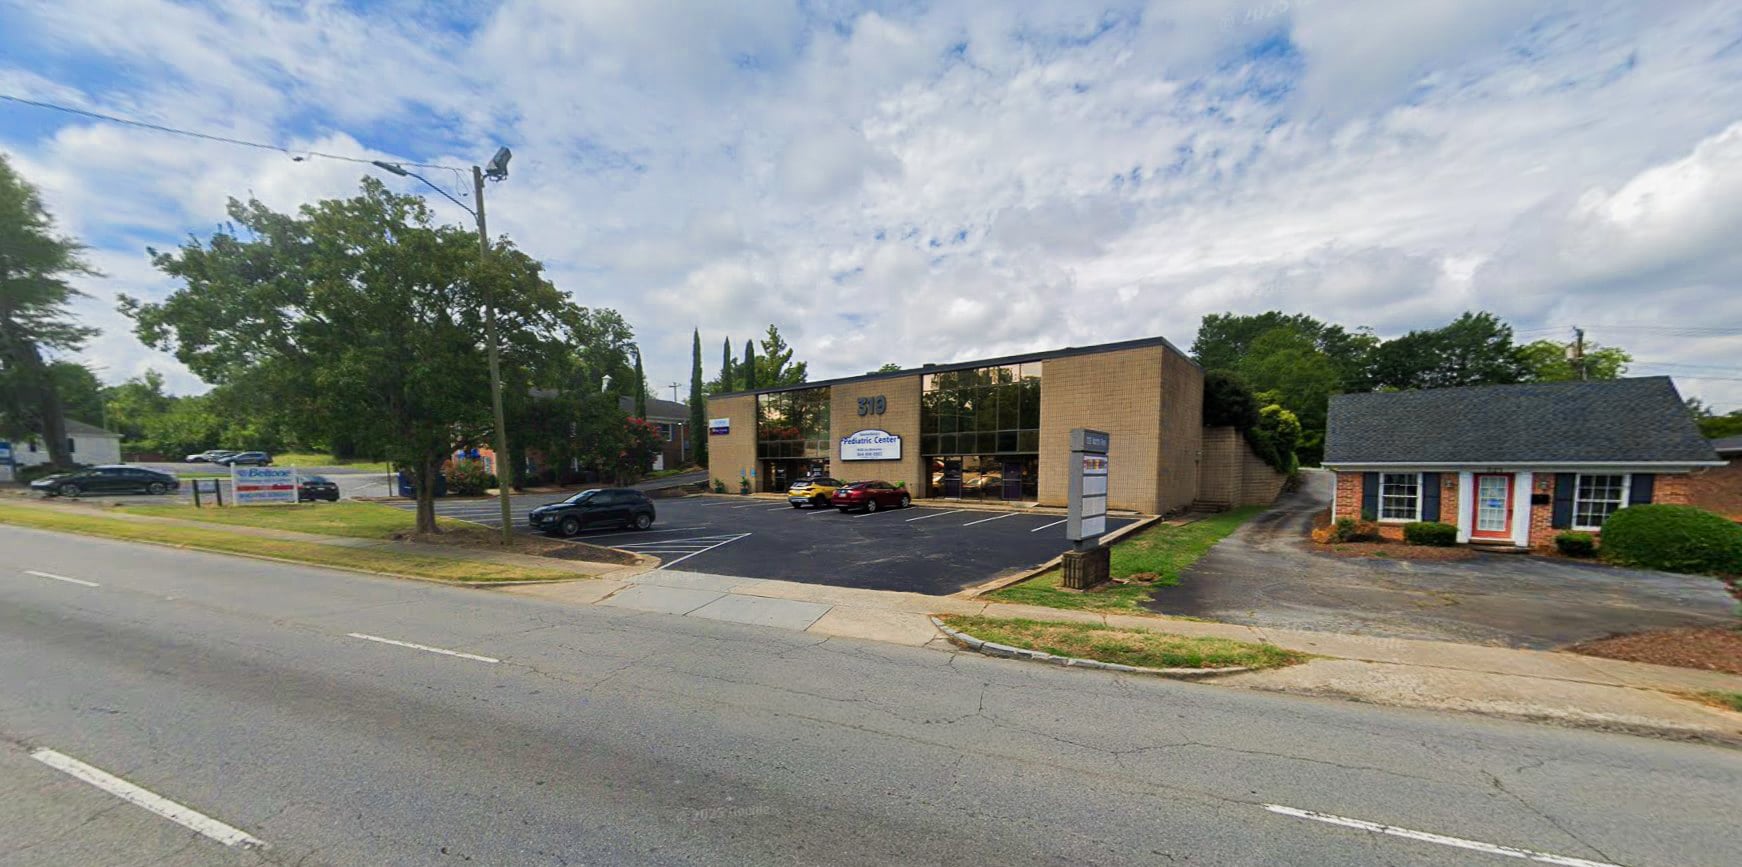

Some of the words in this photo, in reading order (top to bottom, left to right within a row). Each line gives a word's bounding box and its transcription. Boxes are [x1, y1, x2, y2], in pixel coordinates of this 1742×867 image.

[857, 395, 887, 416] 319
[843, 436, 872, 445] Pediatric
[874, 436, 897, 444] Center
